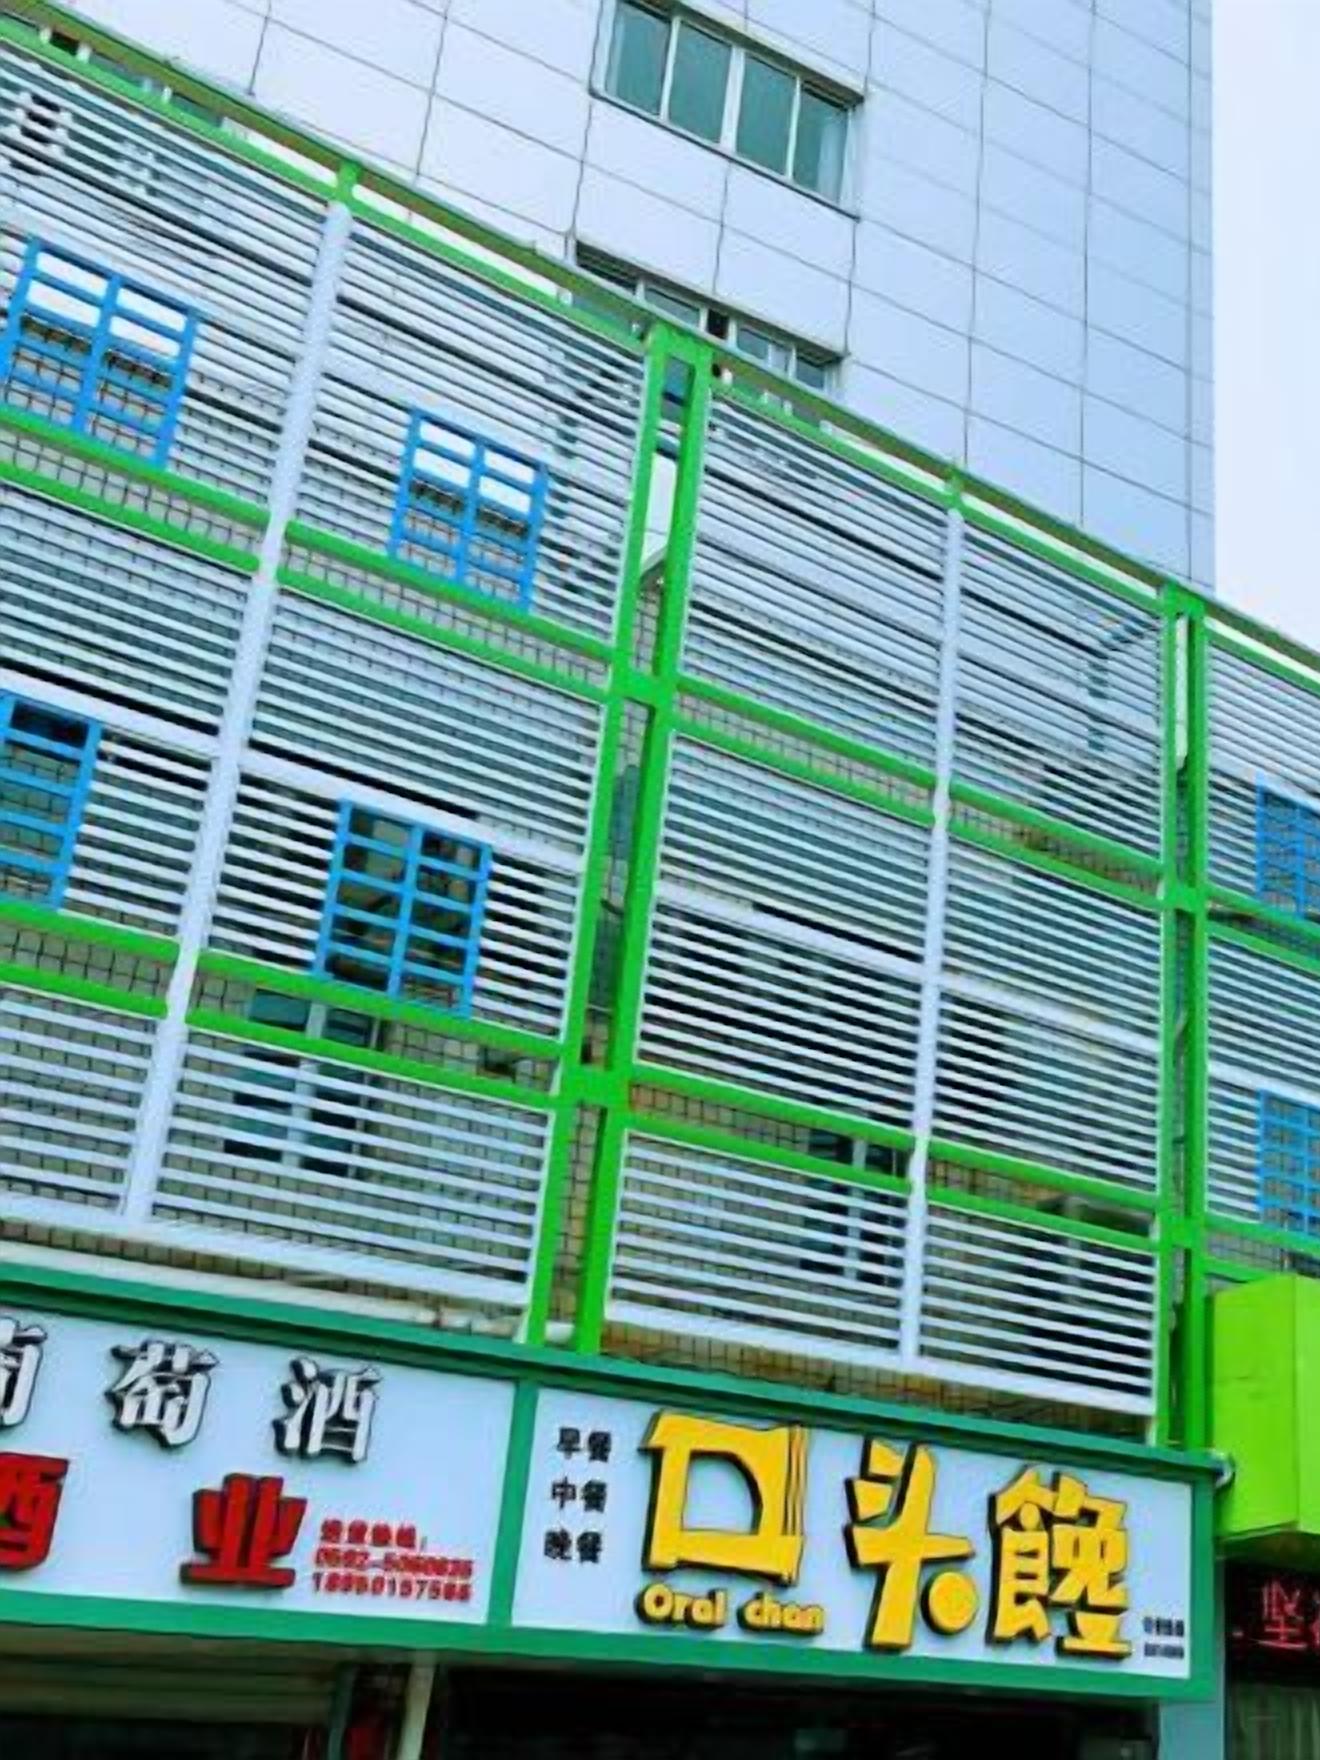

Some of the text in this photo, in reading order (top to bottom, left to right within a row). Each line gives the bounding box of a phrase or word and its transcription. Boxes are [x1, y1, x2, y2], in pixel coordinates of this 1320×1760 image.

[557, 1427, 612, 1462] 早餐
[551, 1477, 608, 1513] 中餐
[544, 1529, 603, 1563] 晚餐
[634, 1582, 824, 1636] Oral chan
